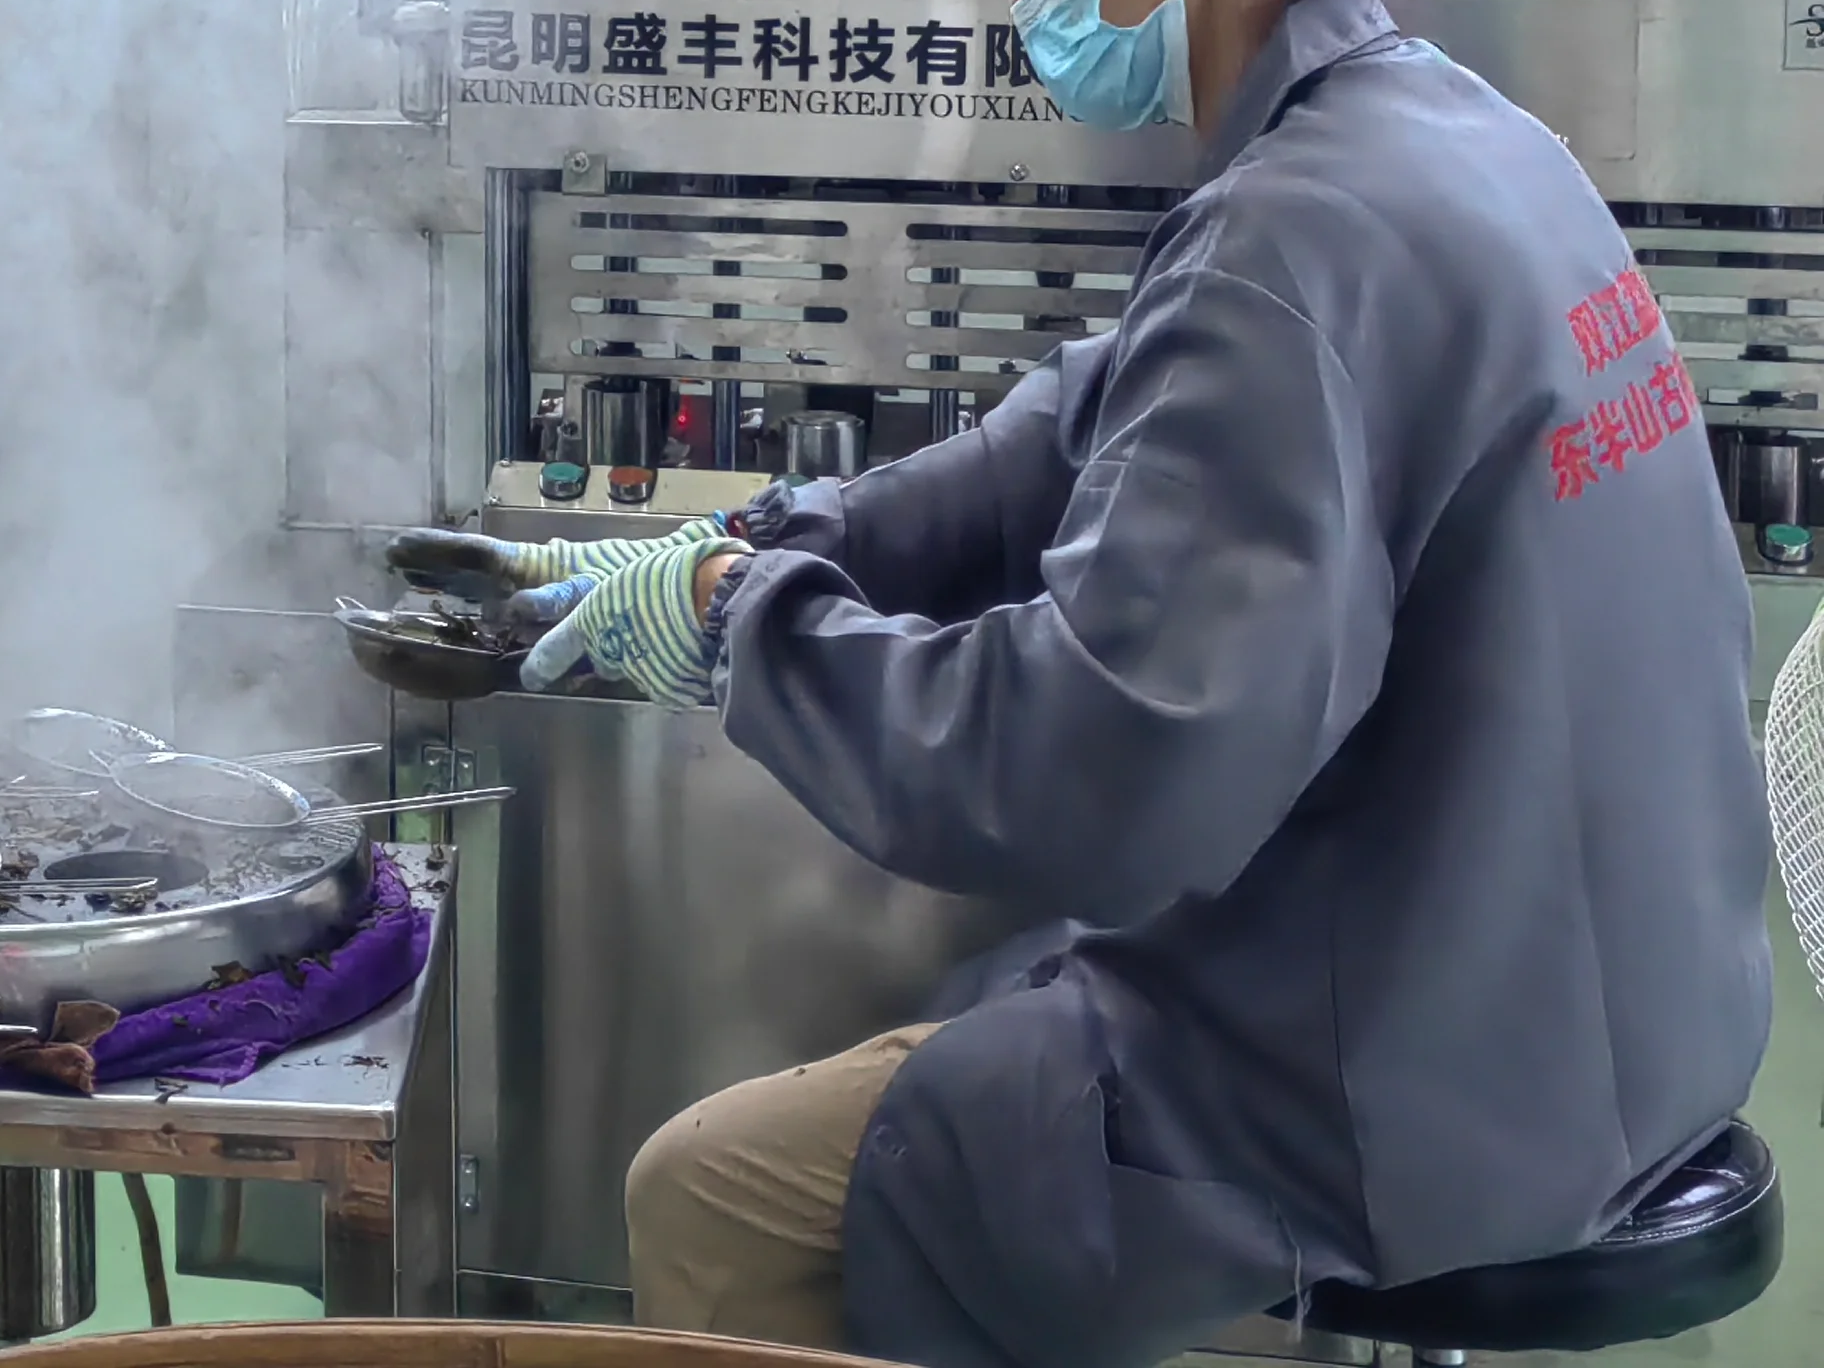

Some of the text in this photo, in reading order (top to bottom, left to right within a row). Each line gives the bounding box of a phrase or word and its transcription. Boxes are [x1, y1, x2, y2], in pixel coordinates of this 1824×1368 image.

[459, 9, 1045, 88] 昆明盛丰科技有限
[460, 79, 1085, 122] KUNMINGSHENGFENGKEJIYOUXIAN
[1549, 352, 1697, 502] 东半山古
